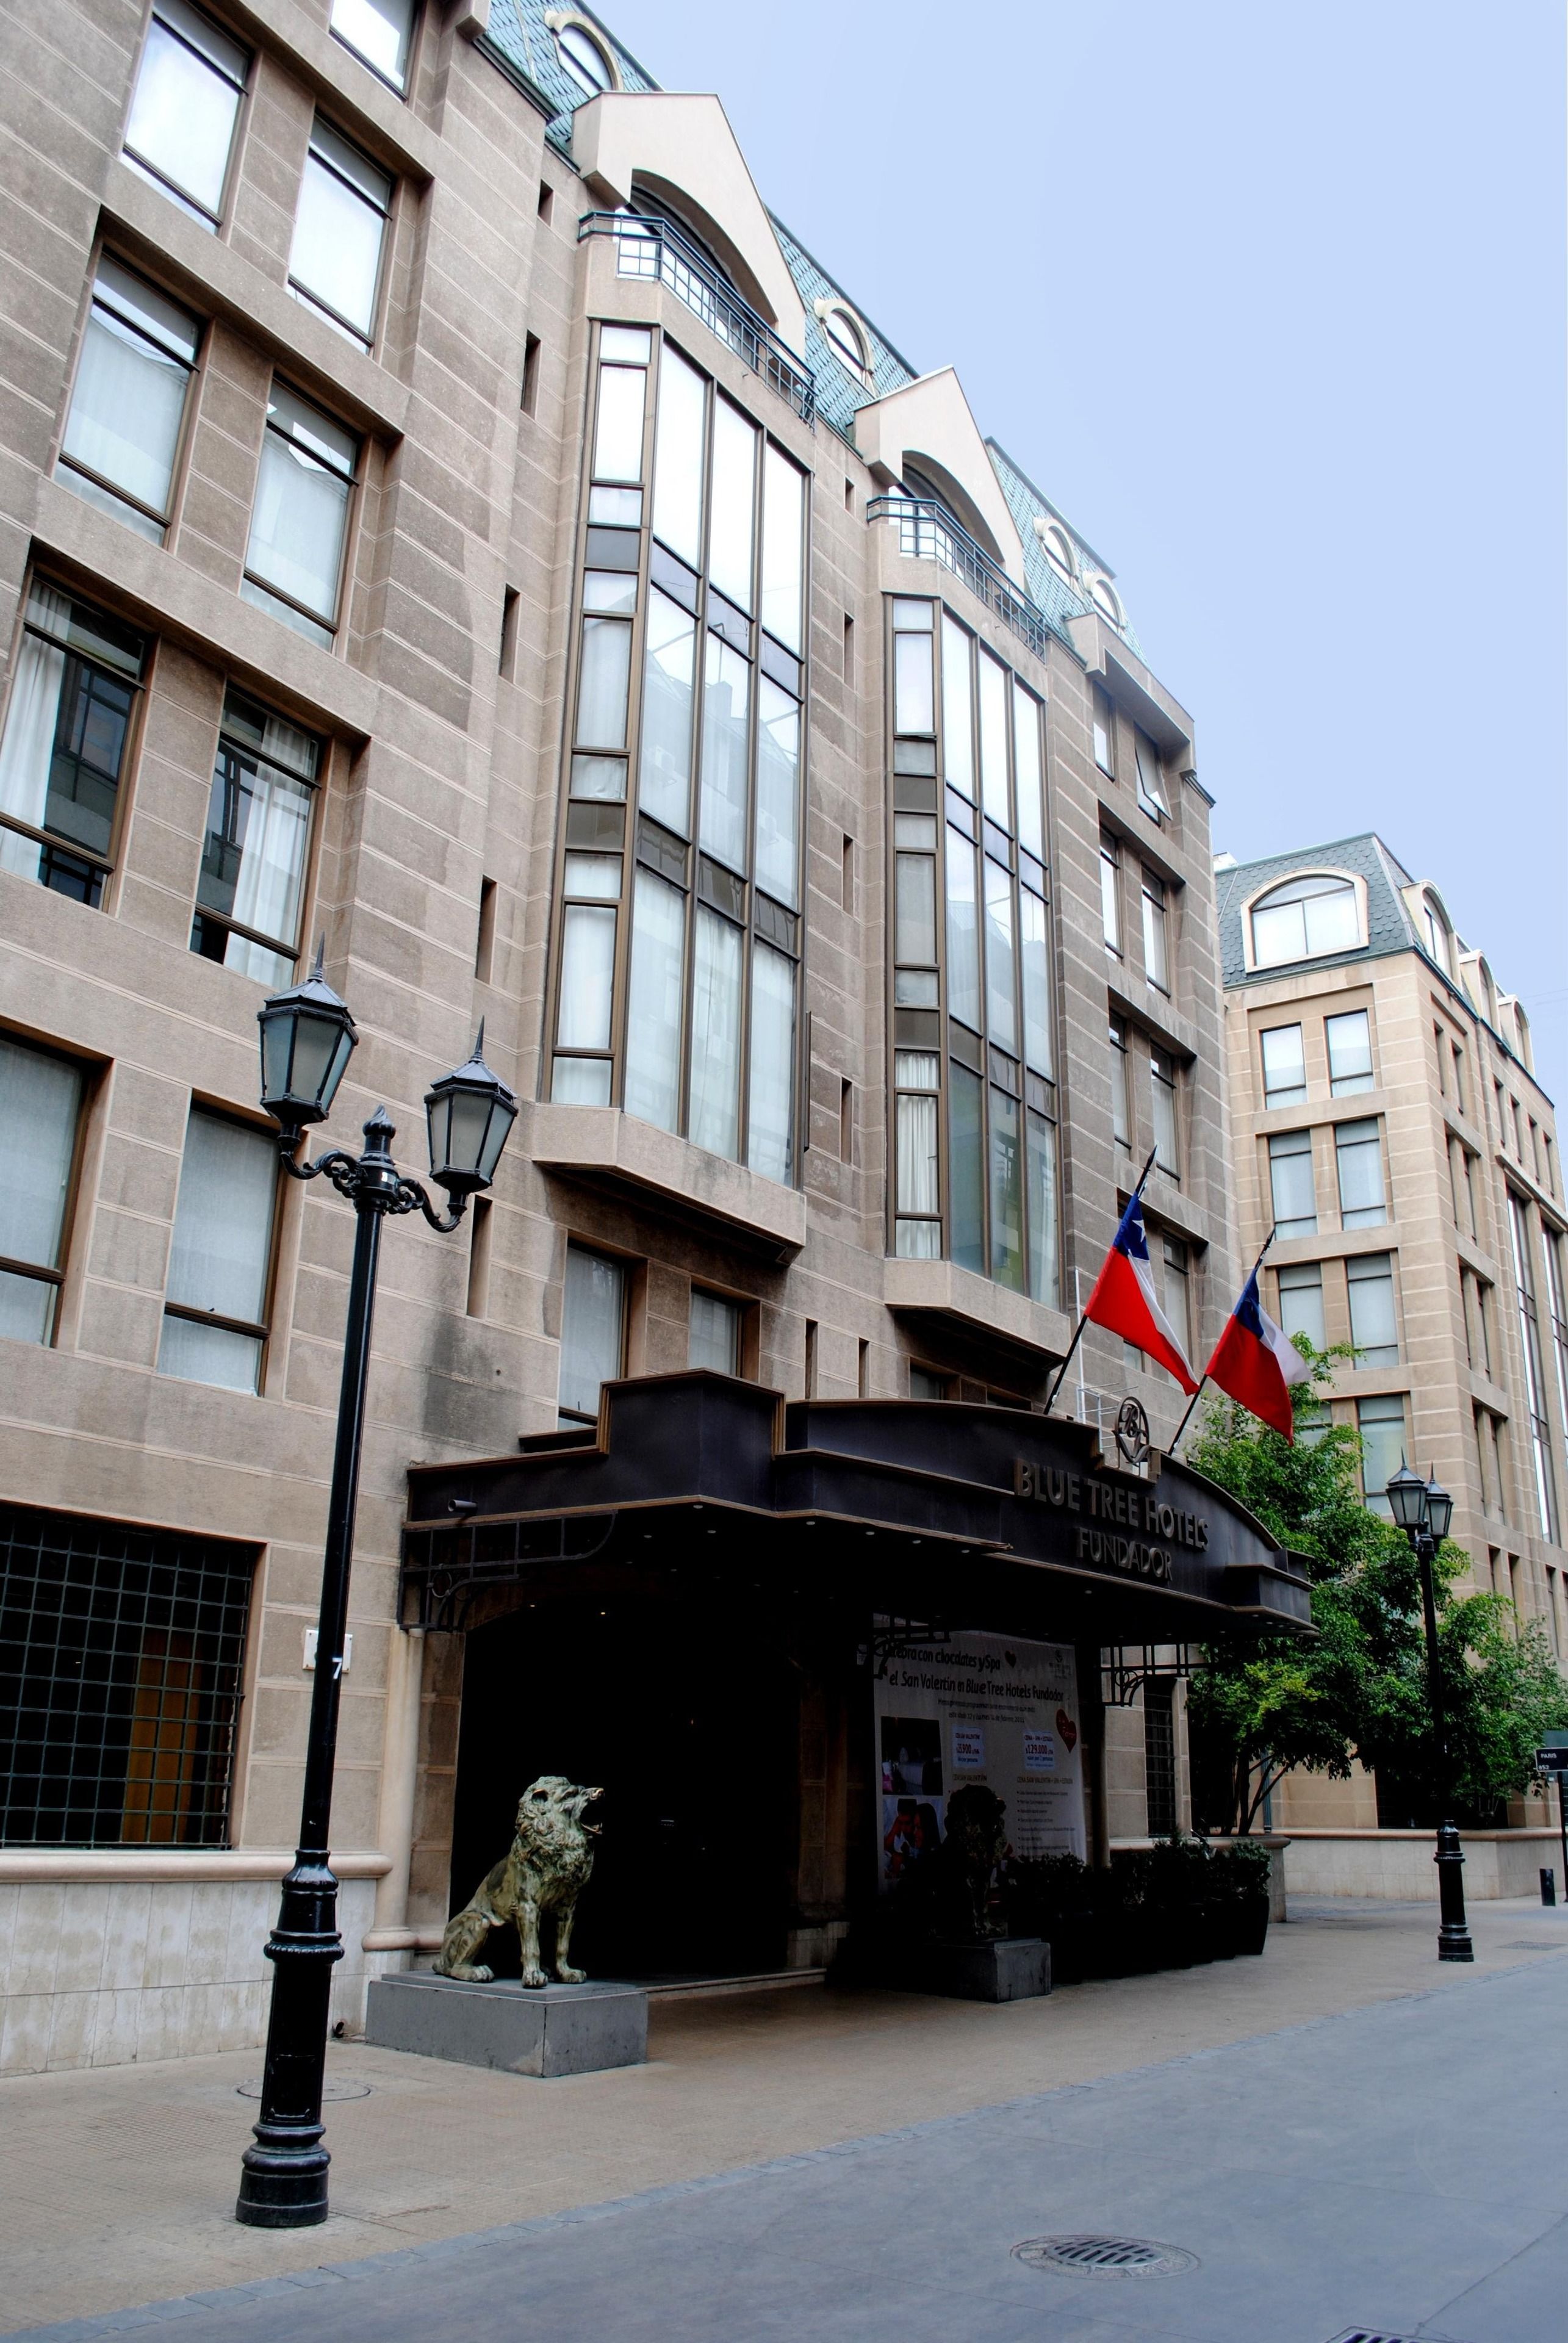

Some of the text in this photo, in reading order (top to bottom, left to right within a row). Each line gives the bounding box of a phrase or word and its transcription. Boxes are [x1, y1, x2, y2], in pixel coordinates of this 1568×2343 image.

[1014, 1458, 1209, 1552] BLUE TREE HOTELS
[1076, 1527, 1173, 1581] FUNDADOR
[331, 1657, 342, 1679] 7
[918, 1649, 933, 1663] con
[890, 1671, 898, 1686] el
[901, 1671, 919, 1688] San
[966, 1679, 986, 1694] Blue
[987, 1680, 1004, 1696] Tree
[1005, 1683, 1031, 1699] Hotels
[1032, 1685, 1063, 1701] Fundador
